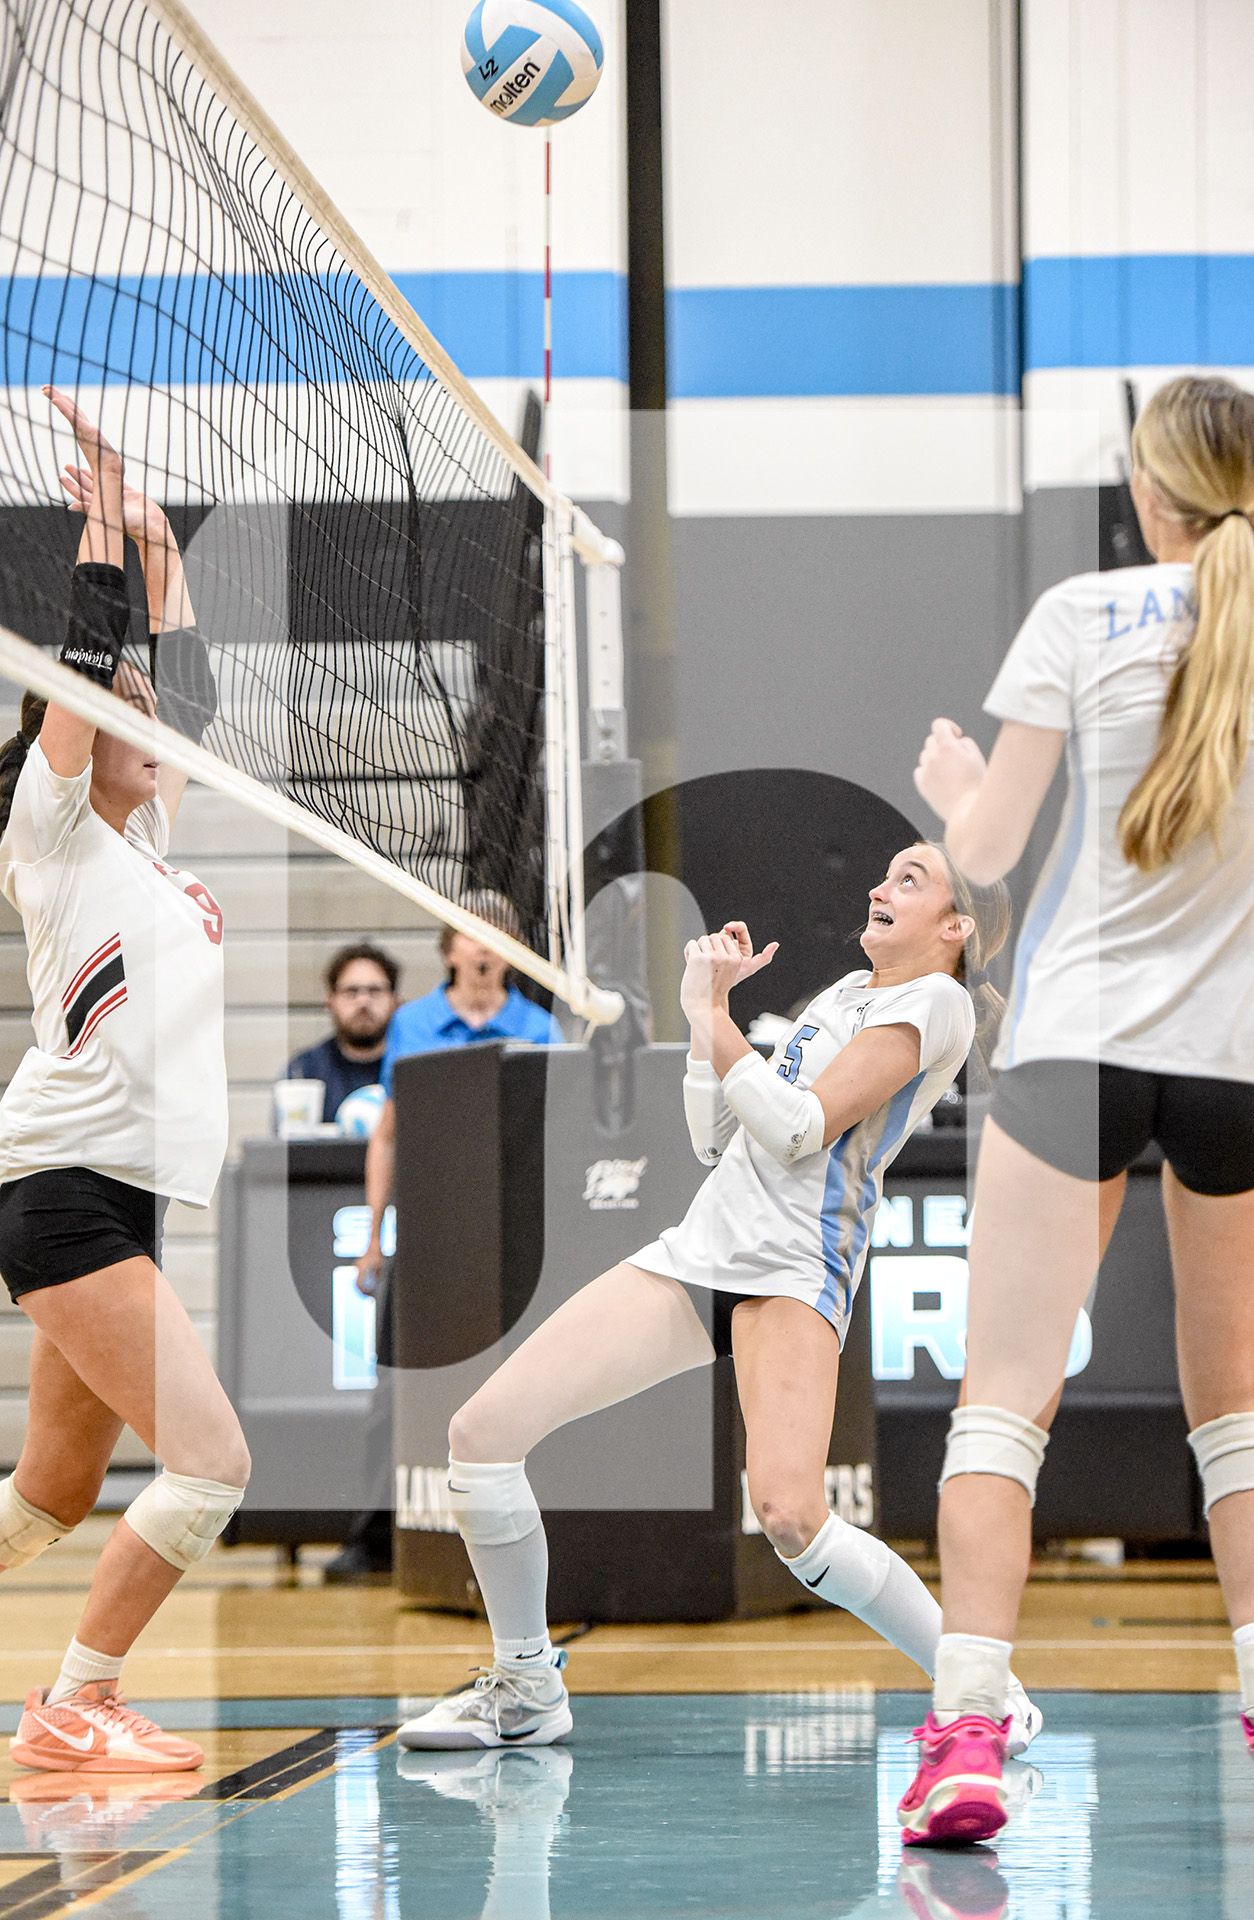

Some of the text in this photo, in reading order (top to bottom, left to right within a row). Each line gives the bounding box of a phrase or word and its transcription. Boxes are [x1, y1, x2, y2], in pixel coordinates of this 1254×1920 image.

[478, 55, 499, 80] L2
[490, 60, 541, 114] molten
[776, 1024, 820, 1085] 5
